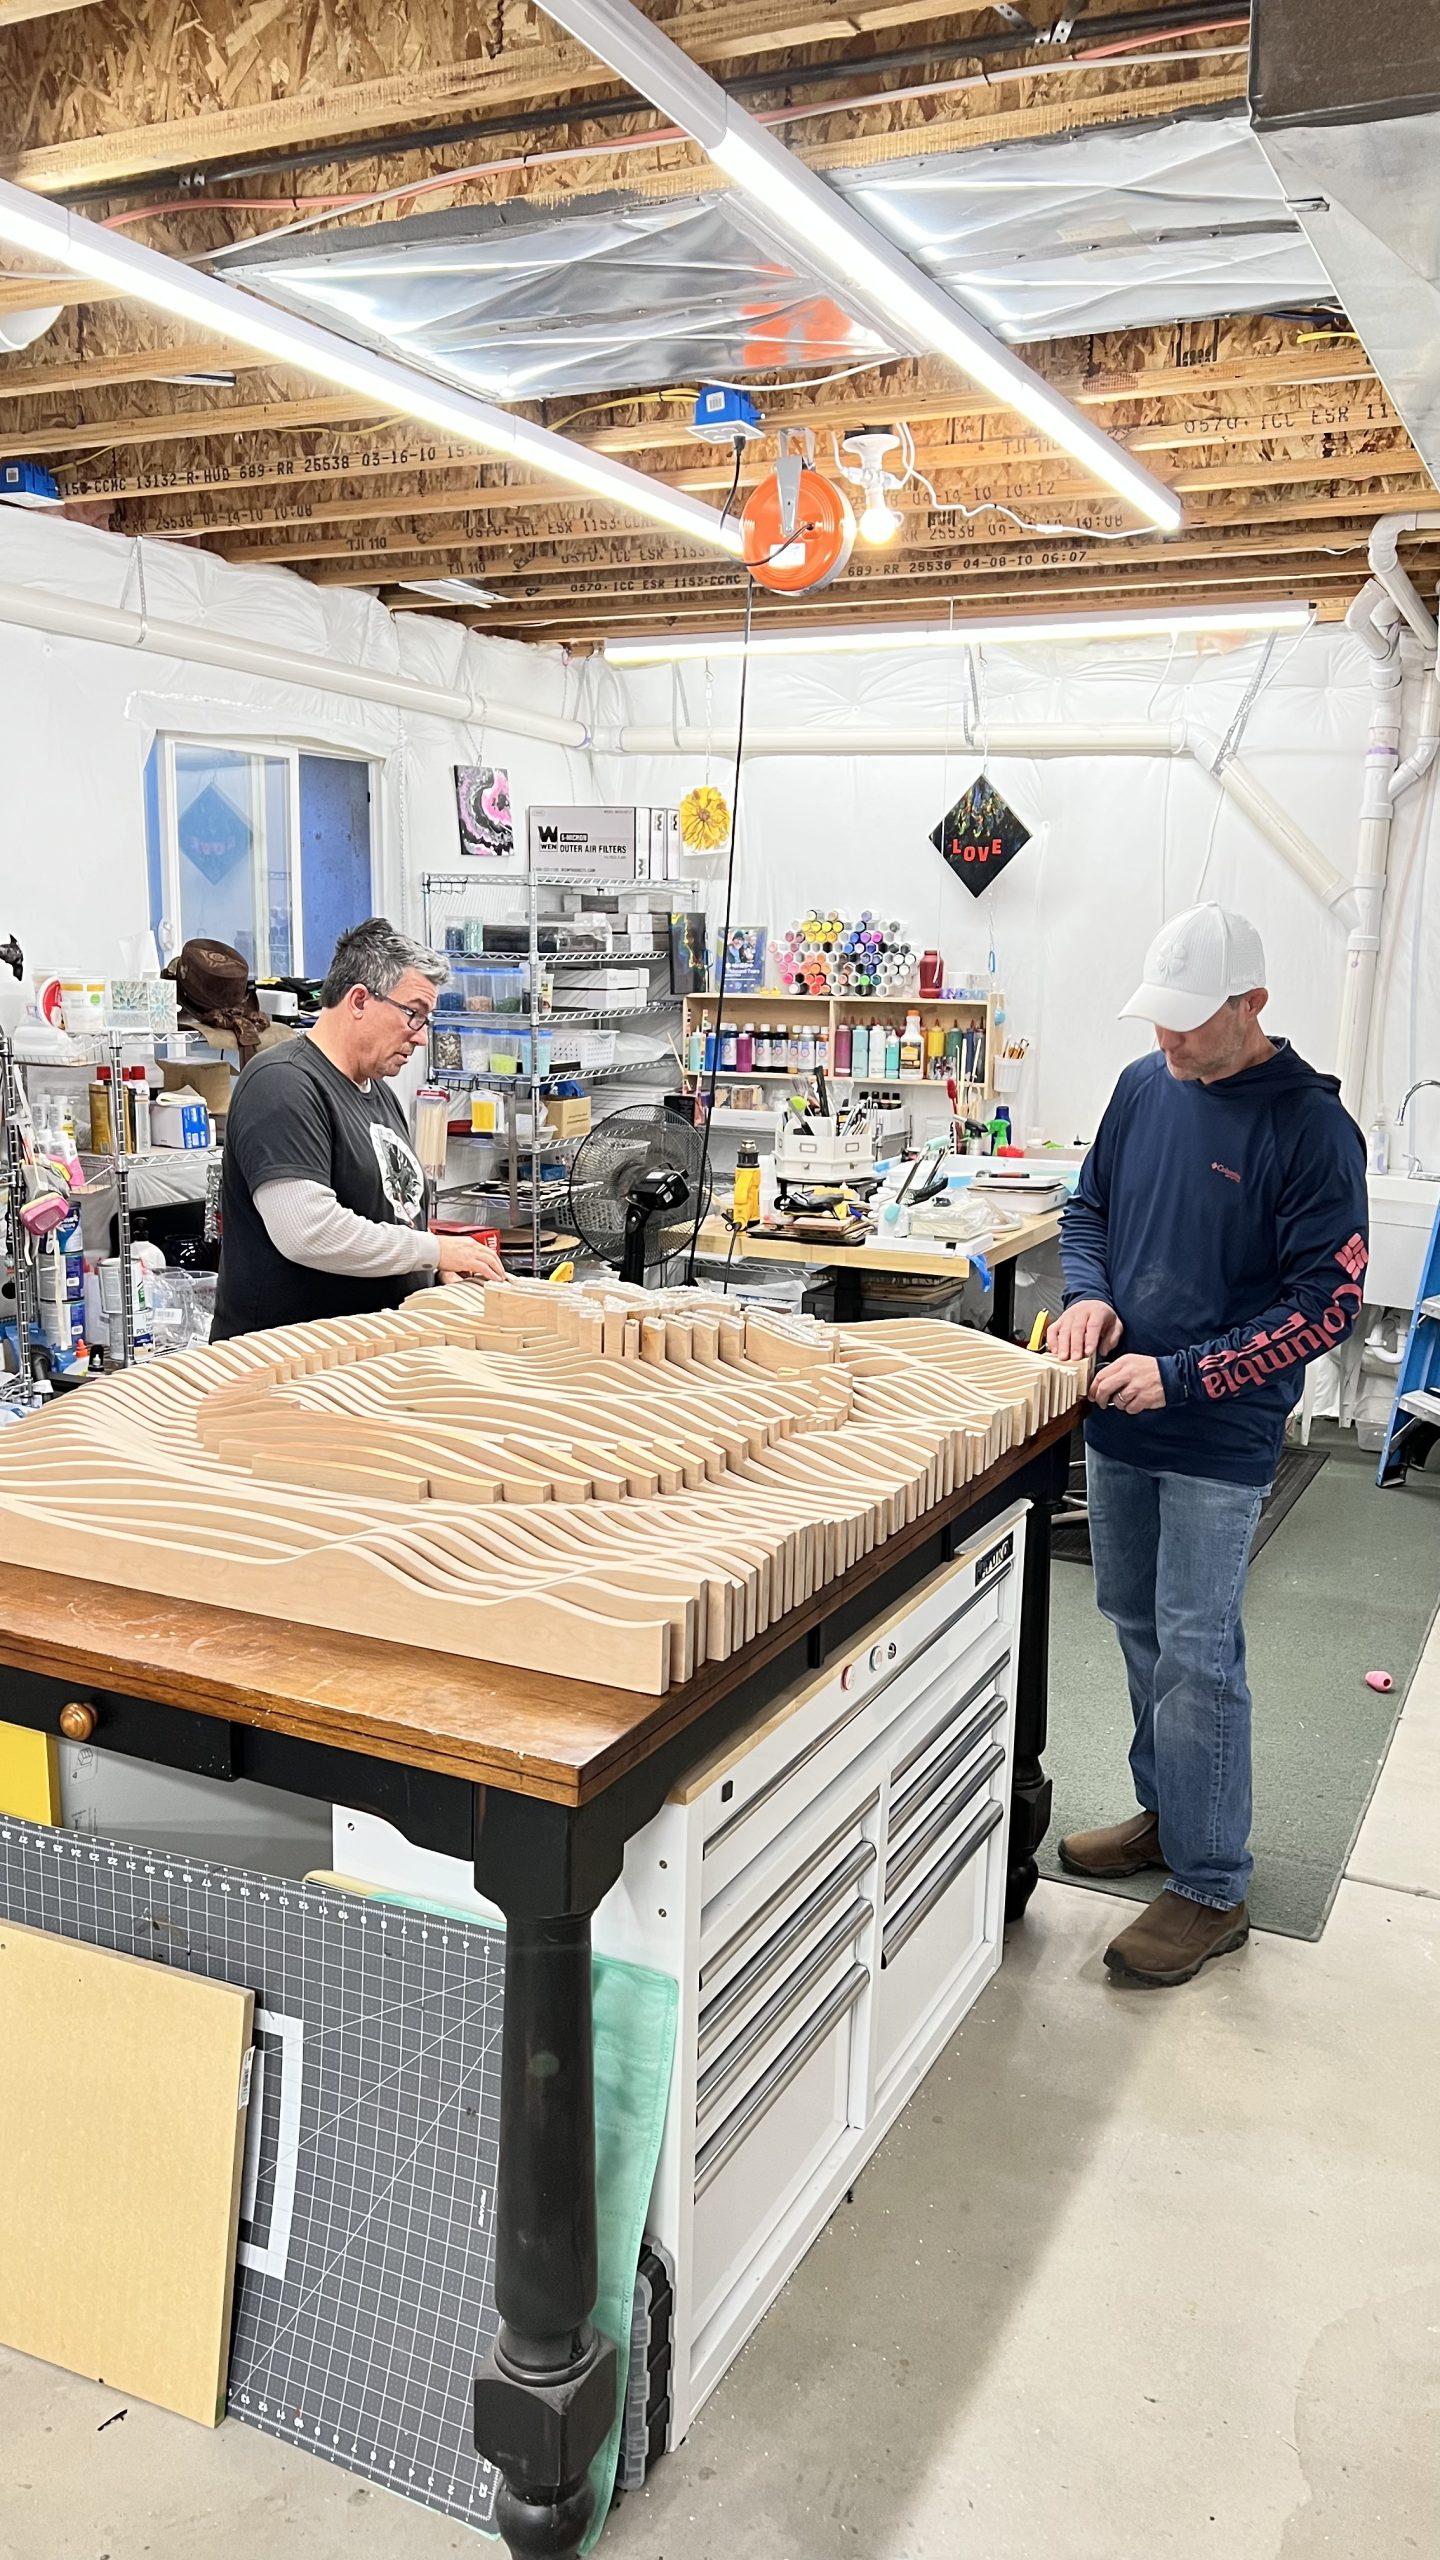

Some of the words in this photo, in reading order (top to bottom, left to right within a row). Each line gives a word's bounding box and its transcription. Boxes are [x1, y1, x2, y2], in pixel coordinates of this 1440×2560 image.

[1311, 406, 1349, 425] ESR
[1367, 403, 1398, 419] 11
[304, 456, 350, 473] 25538
[361, 447, 436, 467] 03-16-10
[1005, 481, 1056, 498] 10:12
[346, 537, 364, 551] TJI
[369, 536, 387, 549] 110
[447, 563, 464, 575] TJI
[468, 561, 486, 574] 110
[613, 581, 635, 592] ICC
[642, 579, 665, 590] ESR
[963, 554, 1033, 570] 04-08-10
[1041, 550, 1087, 564] 06:07
[560, 845, 583, 853] OUTER
[584, 845, 597, 853] AIR
[599, 845, 627, 854] FILTERS
[952, 838, 1002, 862] LOVE
[1202, 1283, 1364, 1399] Columbia
